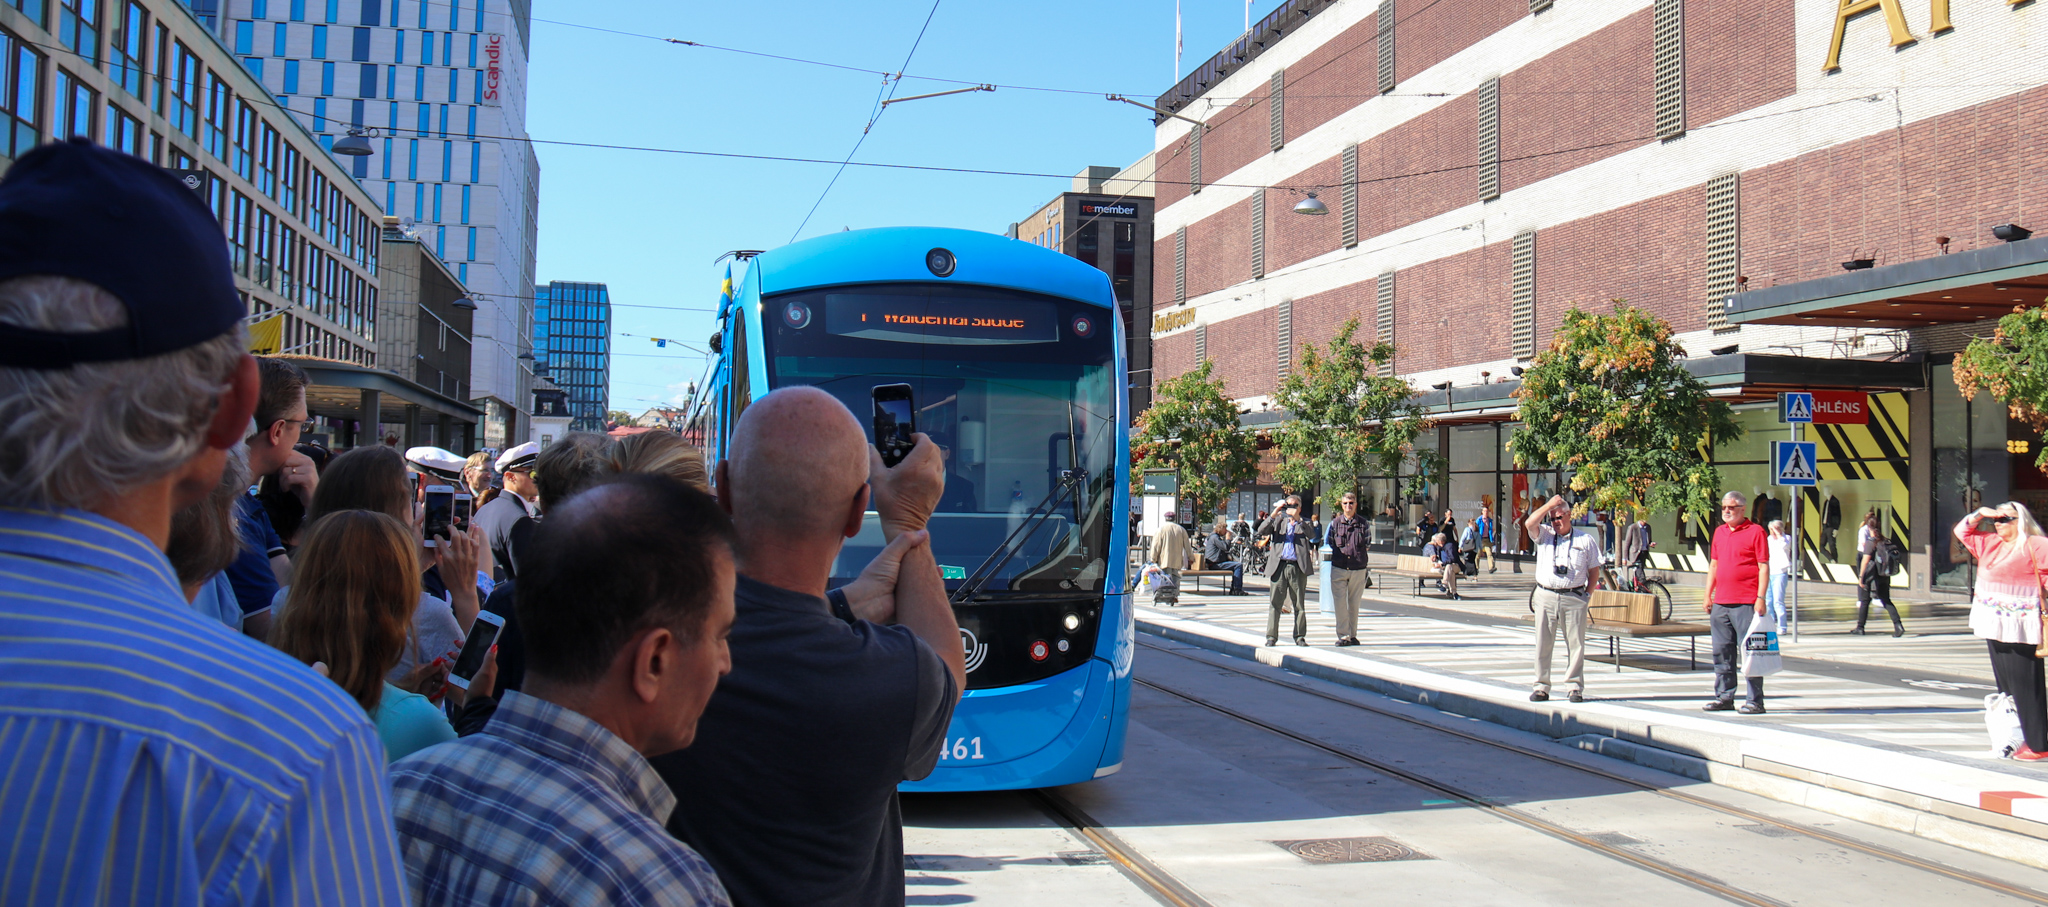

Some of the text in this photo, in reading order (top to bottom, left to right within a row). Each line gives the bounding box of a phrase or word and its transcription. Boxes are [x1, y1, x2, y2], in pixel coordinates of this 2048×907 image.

[484, 35, 501, 101] Scandic
[1082, 204, 1135, 215] re:member
[940, 736, 984, 760] 461
